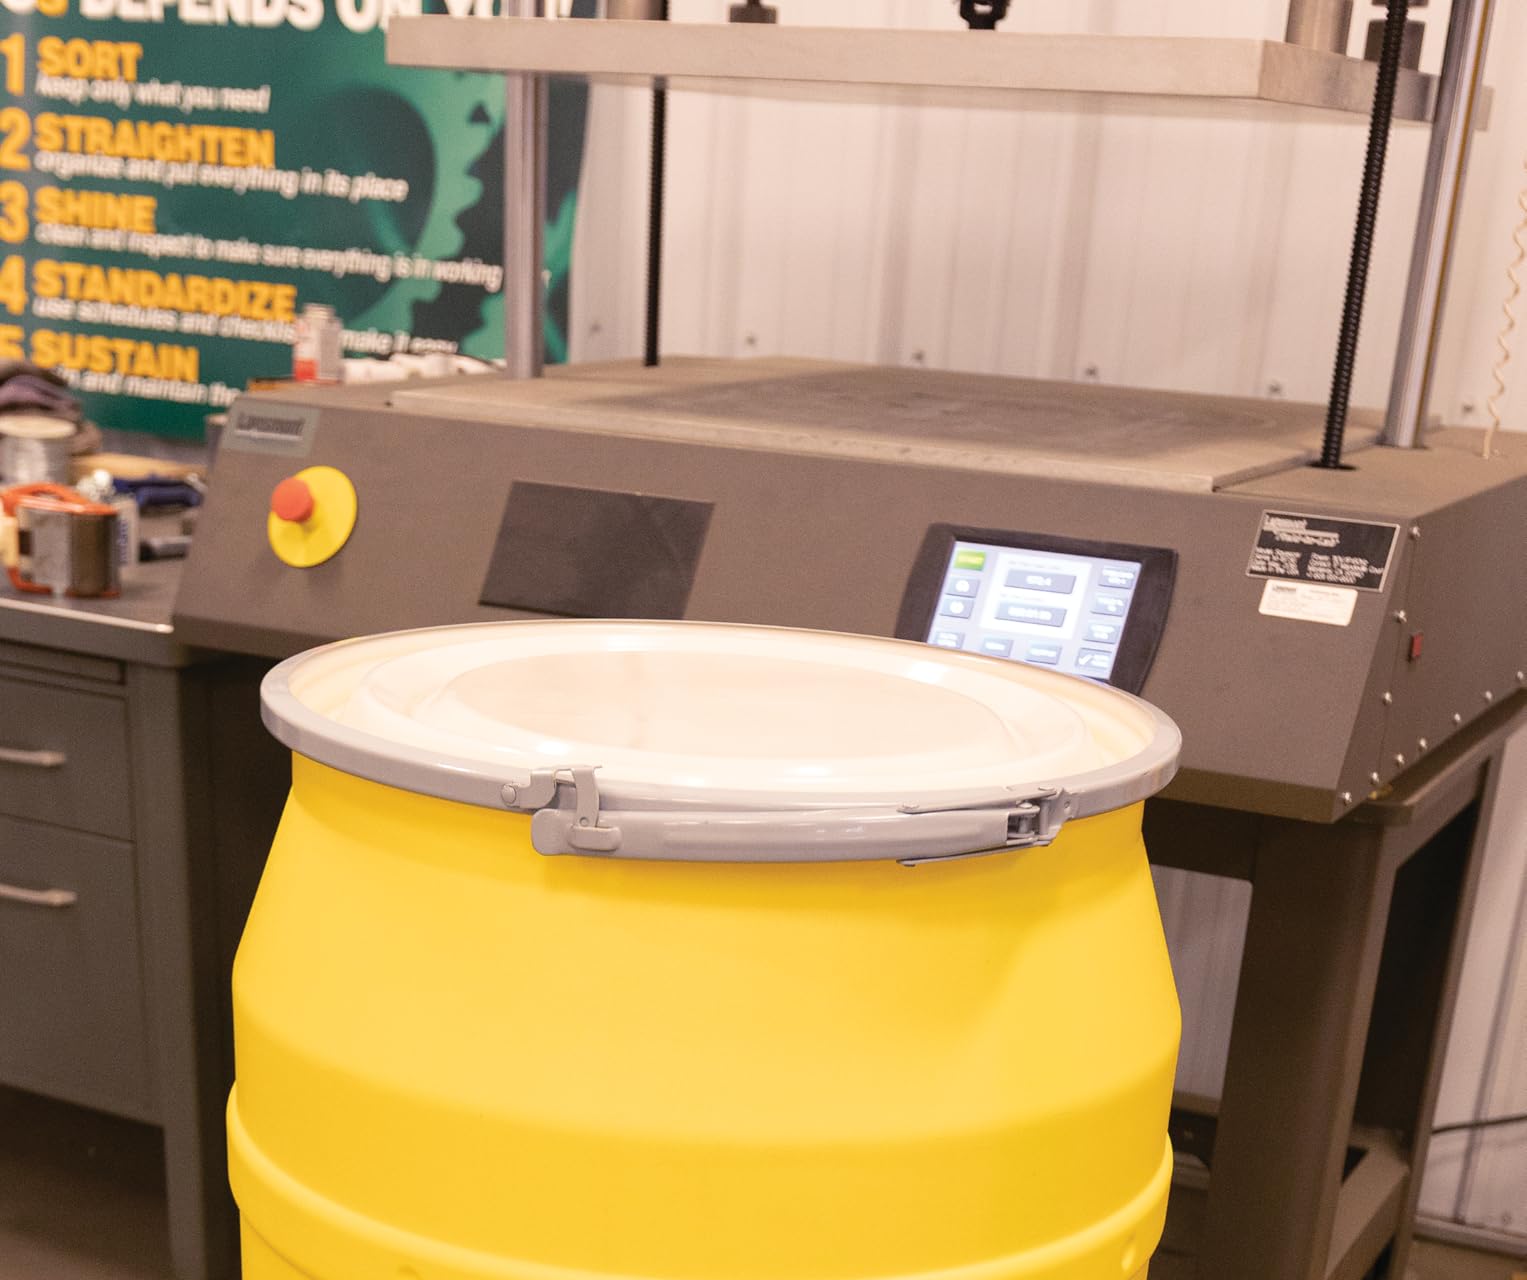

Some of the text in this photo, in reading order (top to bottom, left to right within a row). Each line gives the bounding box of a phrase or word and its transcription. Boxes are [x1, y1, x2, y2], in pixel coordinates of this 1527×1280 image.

[0, 32, 144, 97] 1 SORT
[0, 106, 275, 171] 2 STRAIGHTEN
[0, 179, 157, 244] 3 SHINE
[200, 163, 300, 200] everything
[300, 166, 322, 194] in
[323, 169, 350, 197] its
[350, 172, 409, 204] place
[0, 254, 297, 323] 4 STANDARDIZE
[301, 247, 392, 282] everything
[433, 257, 503, 293] working
[31, 329, 199, 383] SUSTAIN
